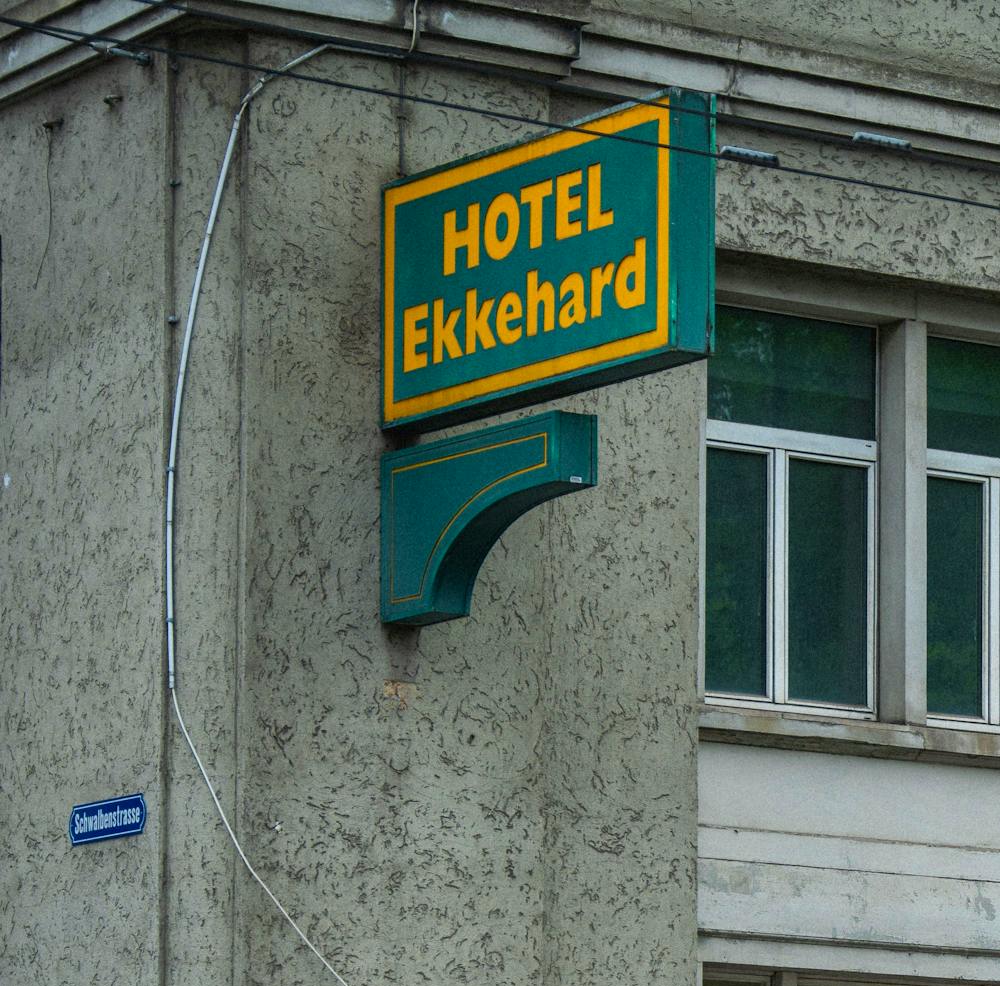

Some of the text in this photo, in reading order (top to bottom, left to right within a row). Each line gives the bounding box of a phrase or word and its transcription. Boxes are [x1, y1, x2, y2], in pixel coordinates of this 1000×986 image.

[443, 162, 615, 277] HOTEL
[403, 236, 647, 374] Ekkehard
[74, 805, 141, 835] Schwalbenstrasse
